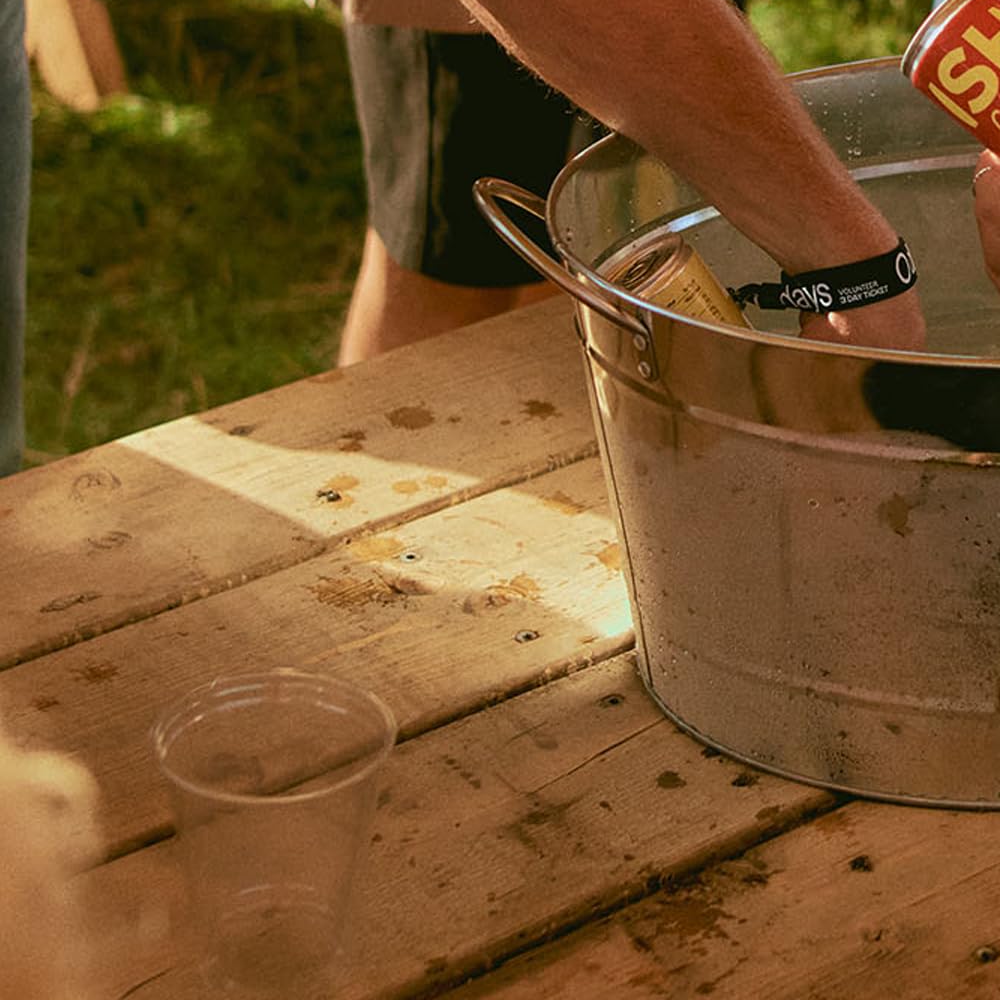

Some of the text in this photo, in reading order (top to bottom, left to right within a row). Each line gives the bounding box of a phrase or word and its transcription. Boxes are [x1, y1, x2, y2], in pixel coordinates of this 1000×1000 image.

[837, 280, 879, 296] VOLUNTEER
[846, 294, 863, 303] DAY
[863, 284, 889, 299] TICKET
[779, 283, 833, 313] days
